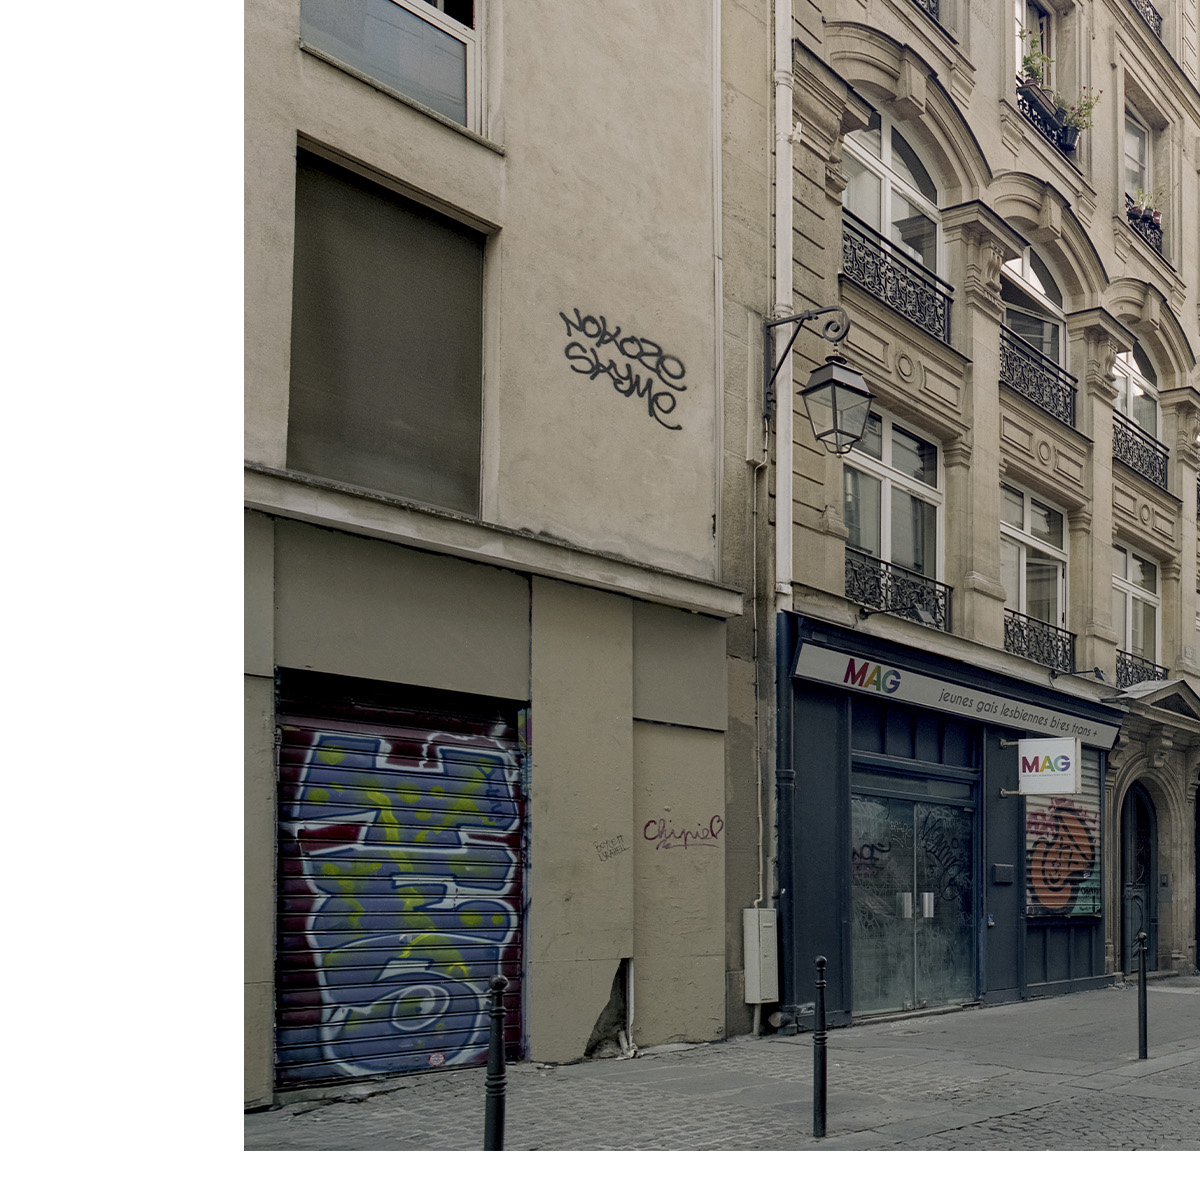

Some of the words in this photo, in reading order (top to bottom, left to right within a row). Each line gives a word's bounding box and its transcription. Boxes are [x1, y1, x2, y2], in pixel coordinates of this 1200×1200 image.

[844, 658, 901, 694] MAG
[939, 688, 974, 708] jeunes
[976, 700, 998, 714] gais
[1000, 703, 1048, 726] lesbiennes
[1072, 723, 1091, 736] trans
[1022, 755, 1071, 773] MAG
